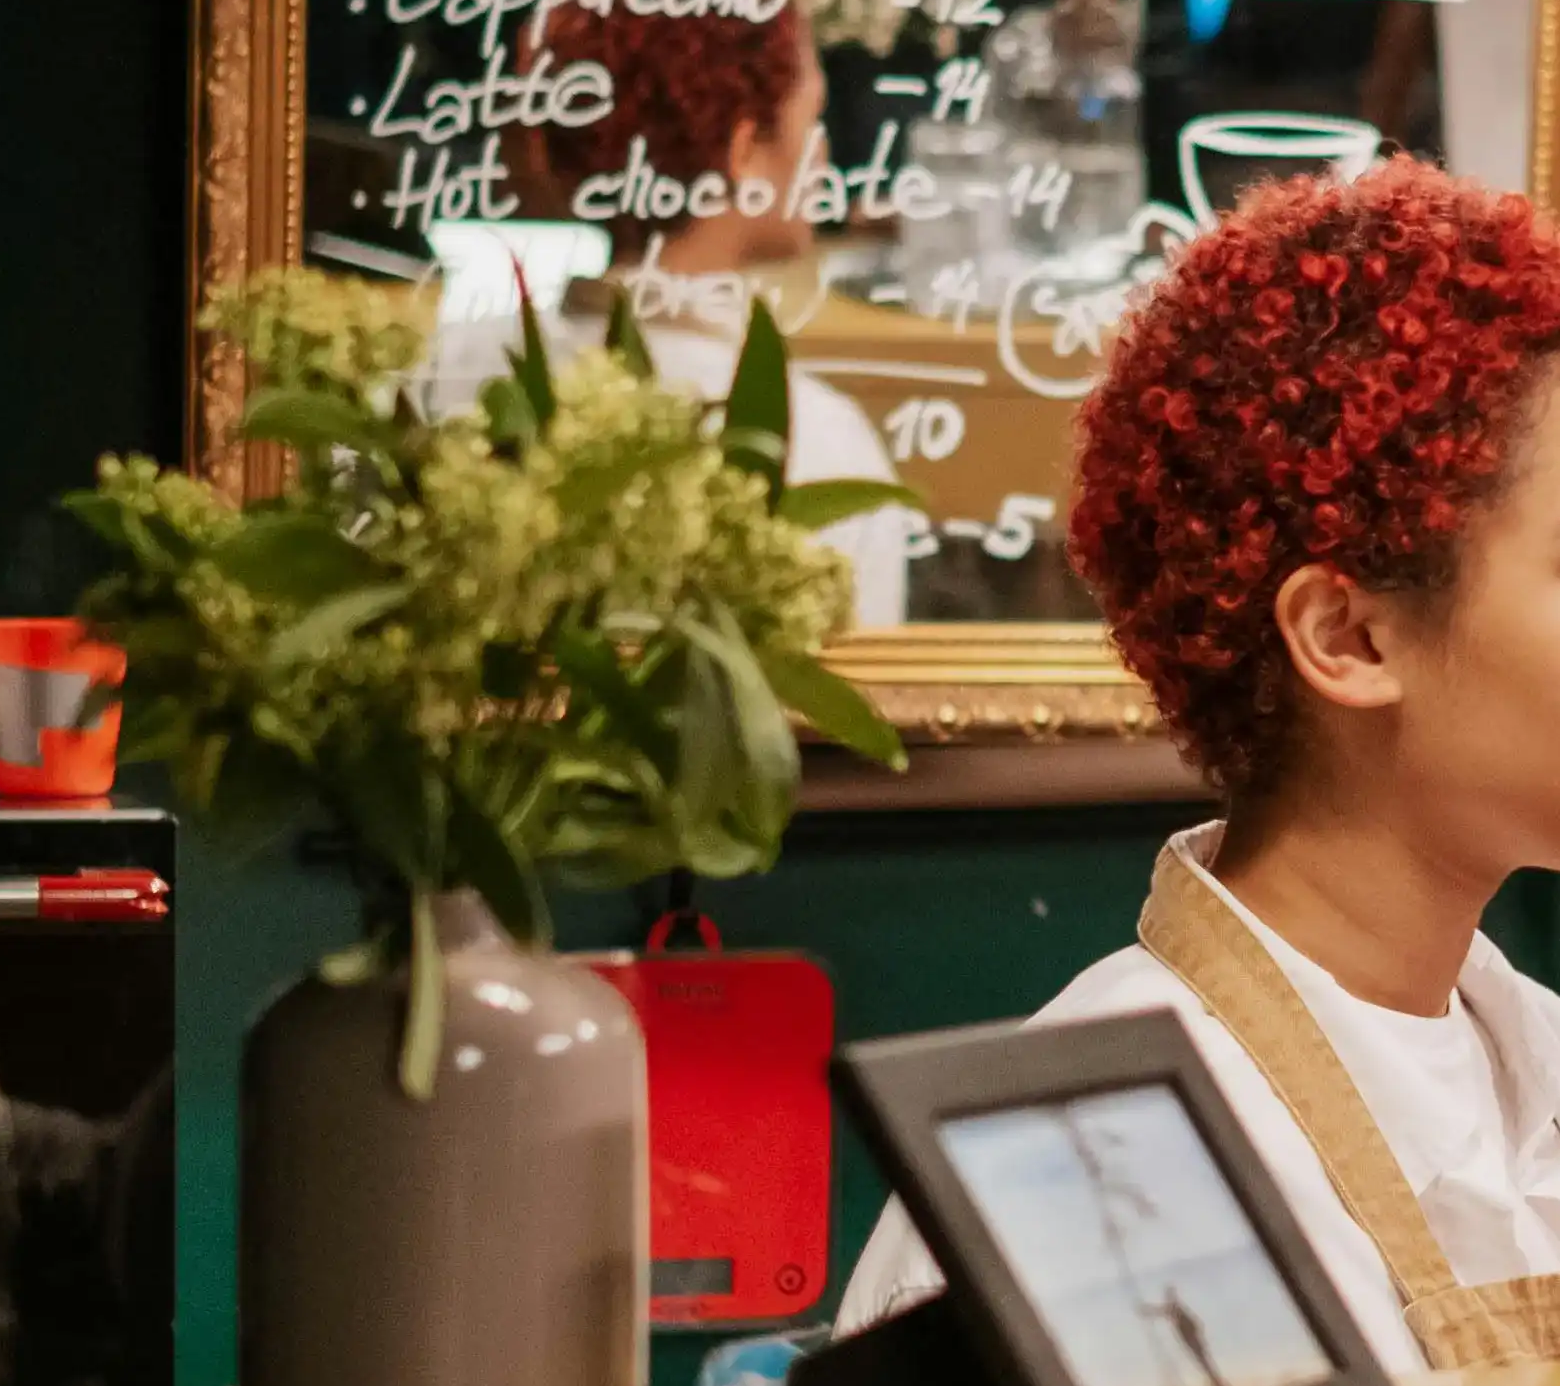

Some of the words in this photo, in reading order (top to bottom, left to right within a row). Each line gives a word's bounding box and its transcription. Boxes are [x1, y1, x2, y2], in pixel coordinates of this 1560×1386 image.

[370, 44, 614, 144] Latte
[383, 134, 520, 233] Hot
[573, 121, 952, 223] chocolate
